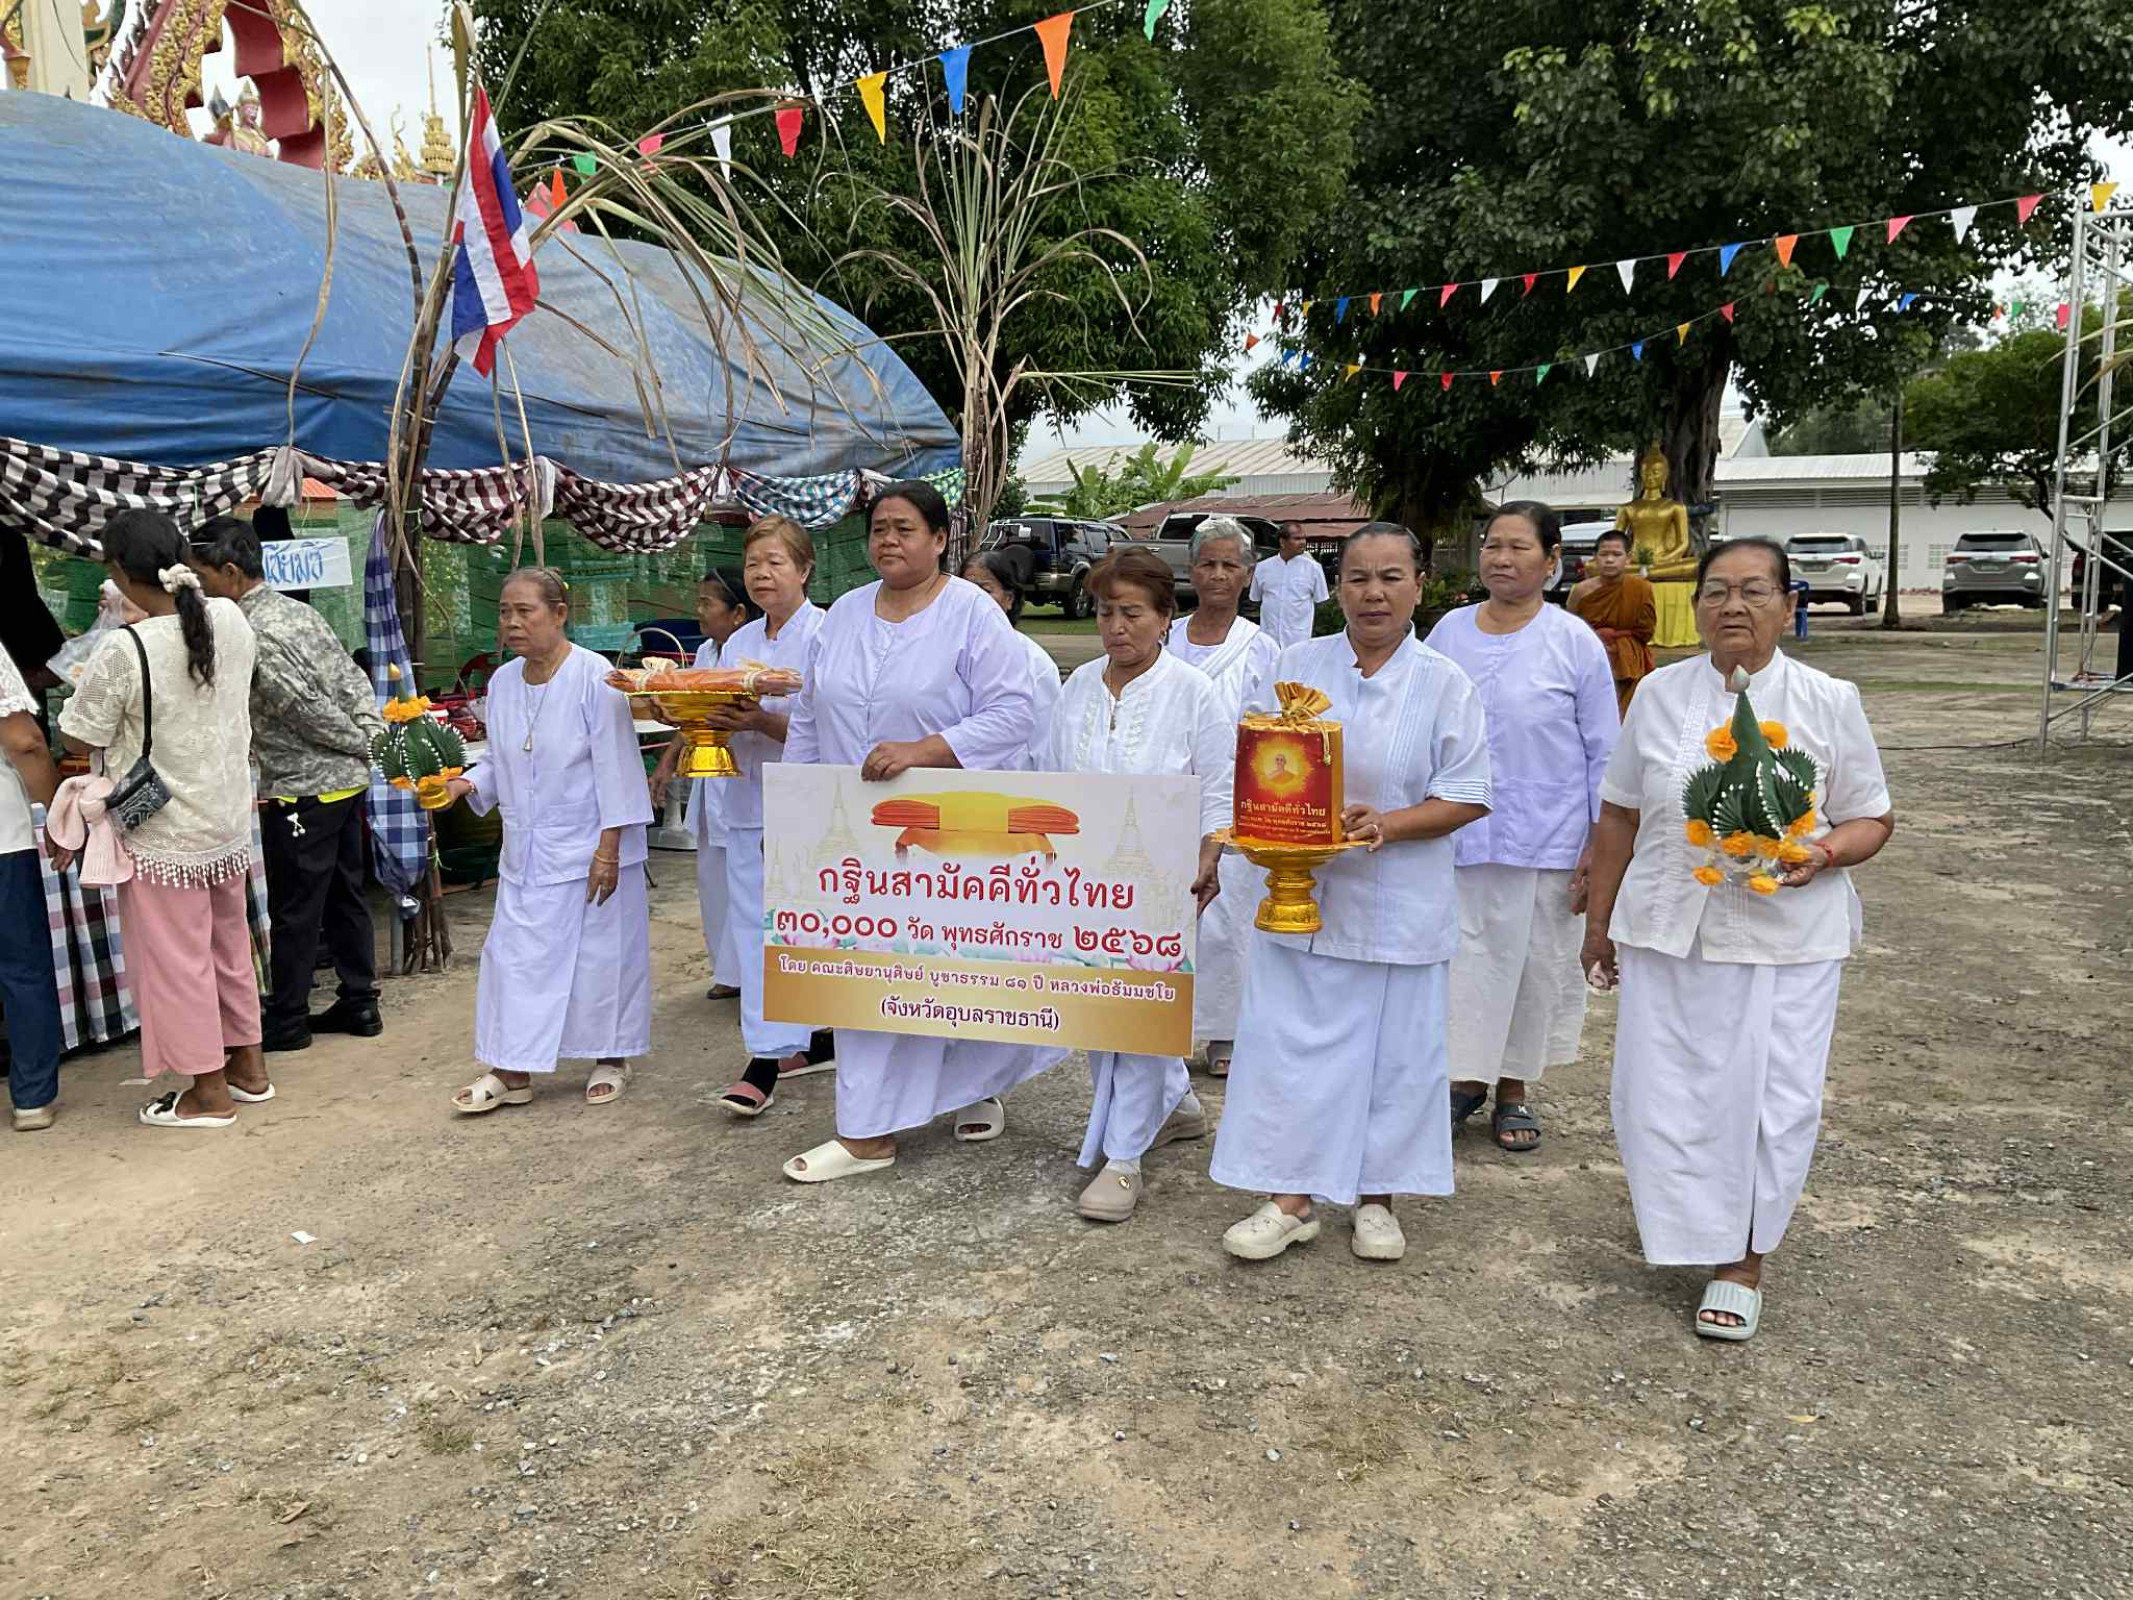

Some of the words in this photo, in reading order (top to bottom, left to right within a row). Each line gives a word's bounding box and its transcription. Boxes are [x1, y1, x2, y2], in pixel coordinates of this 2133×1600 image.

[1240, 799, 1326, 817] กฐินสามัคคีทั่วไทย
[818, 855, 1135, 910] กฐินสามัคคีทั่วไทย
[776, 908, 898, 939] ๓๐,๐๐๐
[907, 916, 935, 942] วัด
[941, 922, 1063, 956] พุทธศักราช
[1073, 925, 1182, 958] ๒๕๖๘
[779, 956, 807, 973] โดย
[812, 961, 924, 983] คณะศิษยานุศิษย์
[929, 970, 999, 988] บูชาธรรม
[1005, 977, 1027, 990] ๘๑
[1033, 974, 1044, 991] ปี
[1050, 979, 1176, 1001] หลวงพ่อธัมมชโย
